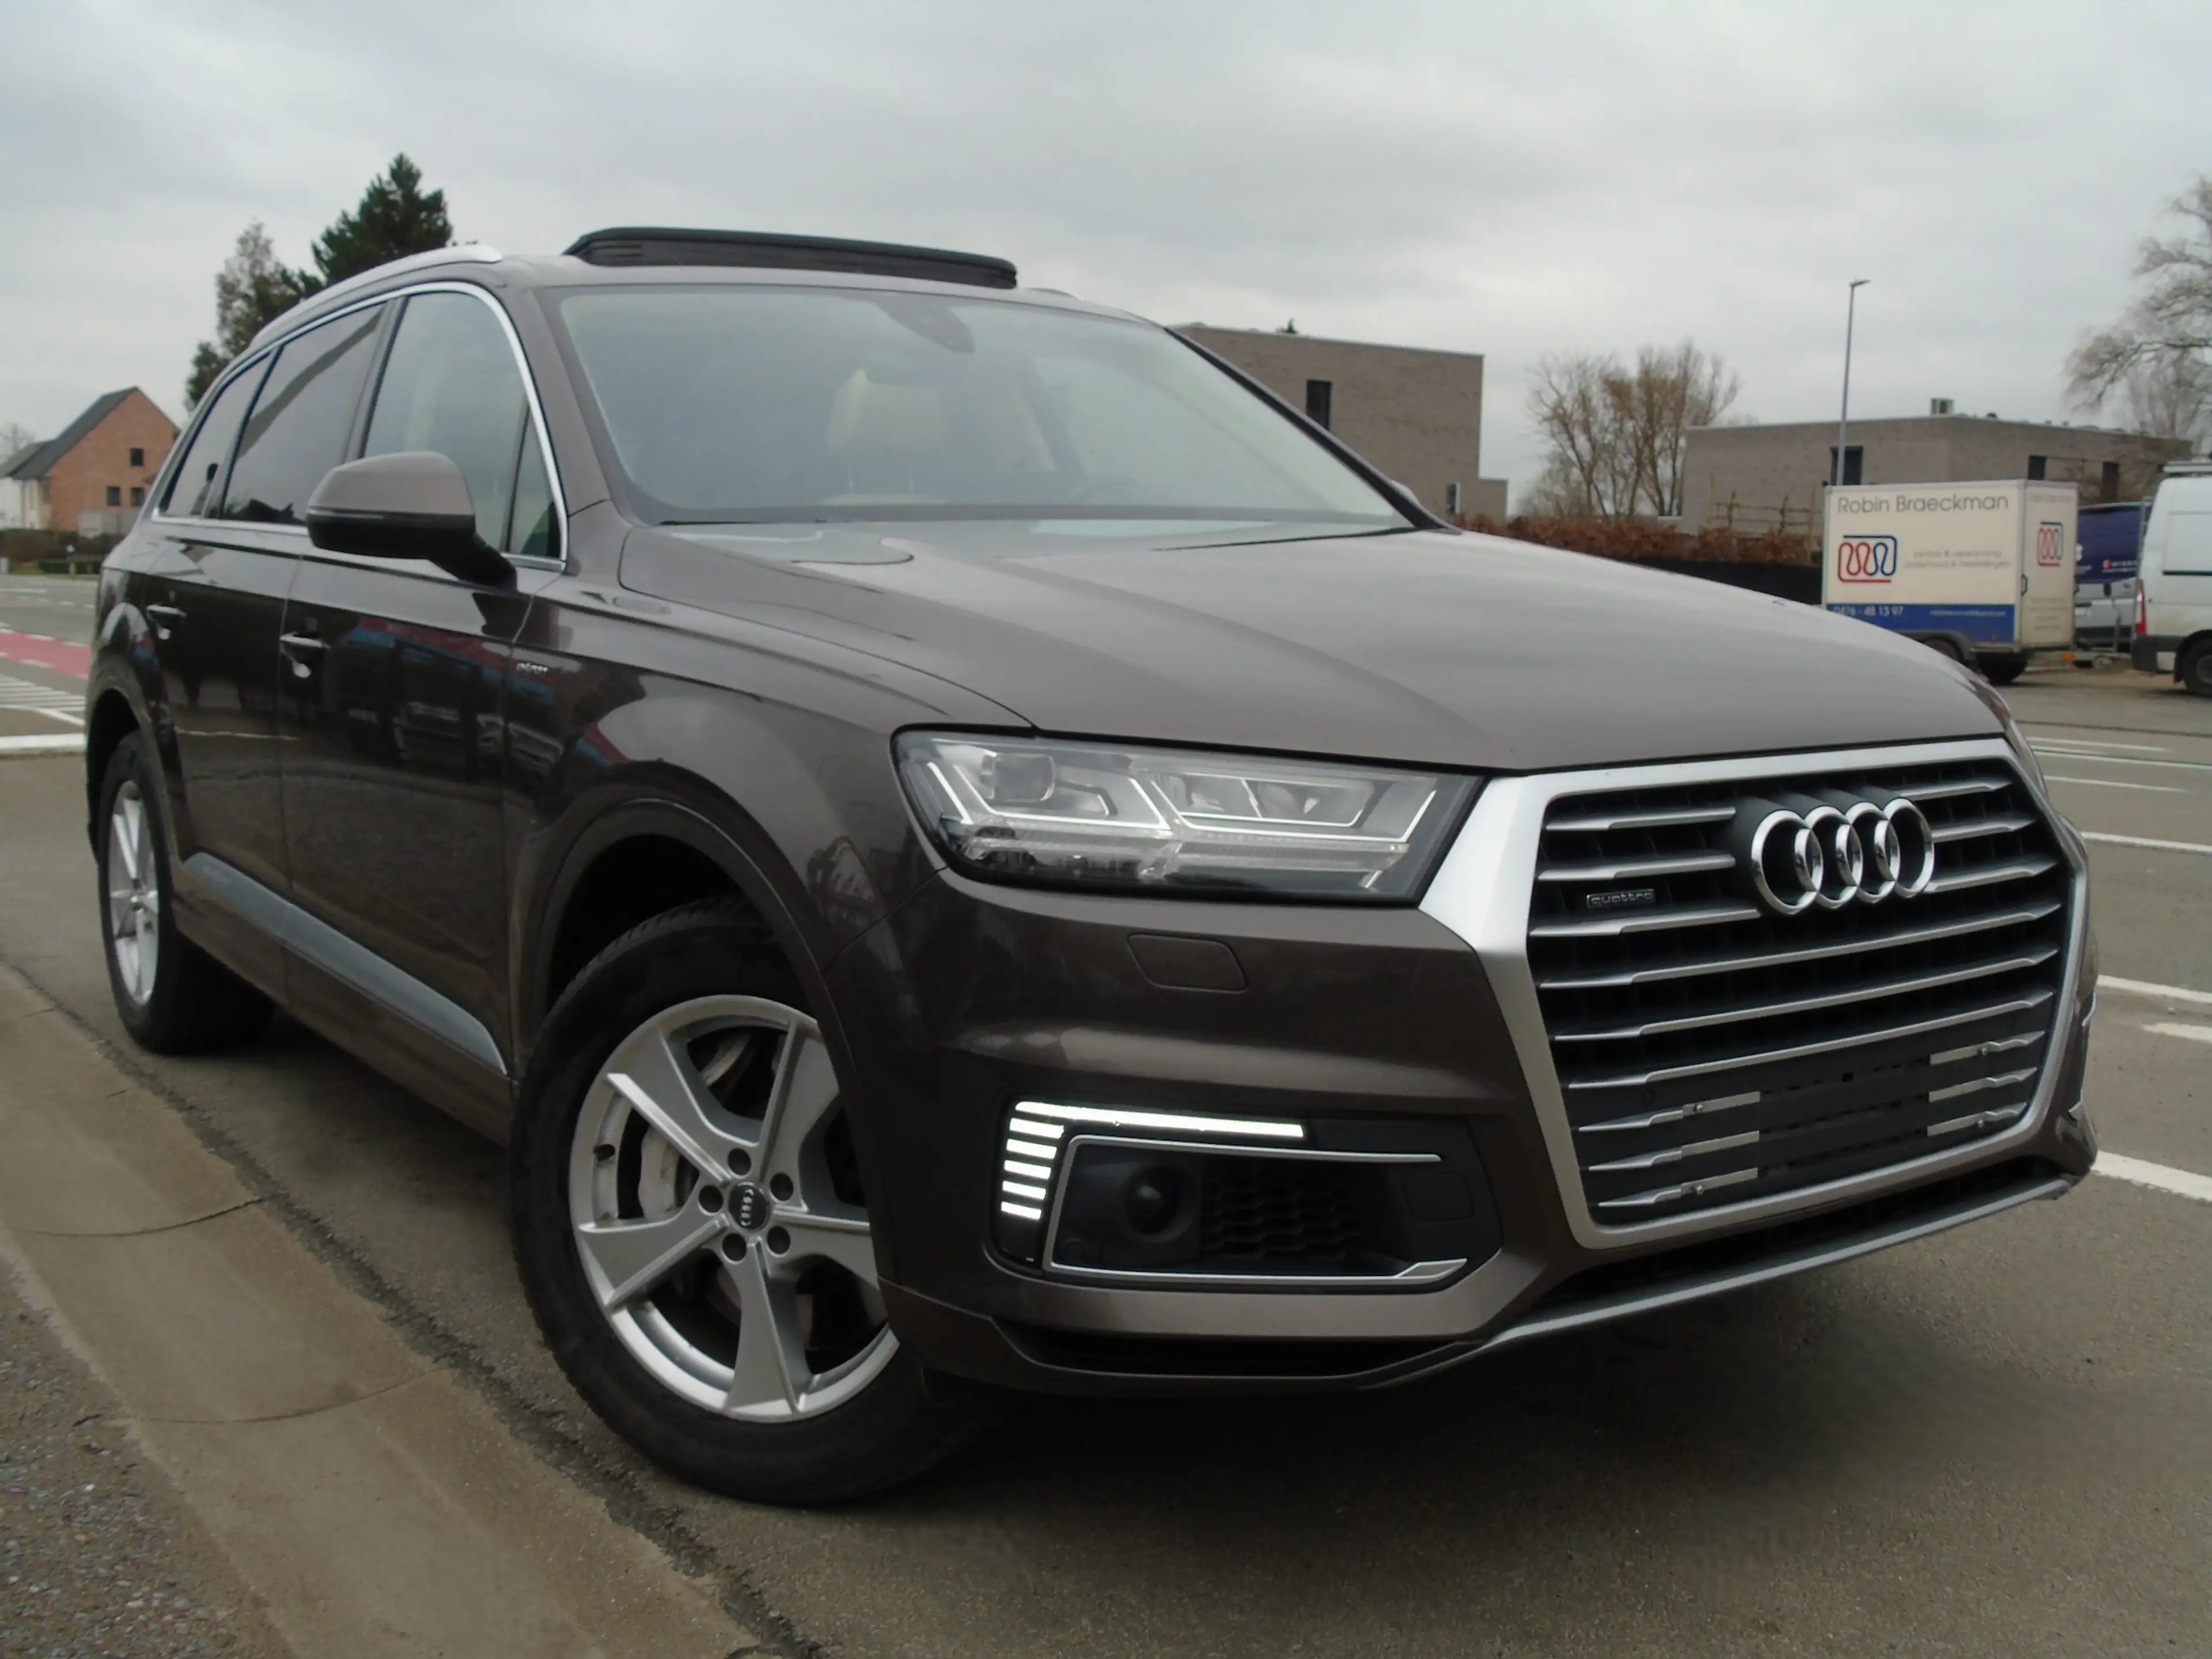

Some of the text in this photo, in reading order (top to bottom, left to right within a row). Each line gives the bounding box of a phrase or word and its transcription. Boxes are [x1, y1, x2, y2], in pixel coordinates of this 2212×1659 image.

[1837, 495, 1890, 514] Robin
[1896, 494, 2009, 513] Braeckman
[1878, 605, 1890, 617] 13
[1891, 605, 1904, 616] 97
[1591, 892, 1653, 907] quattro
